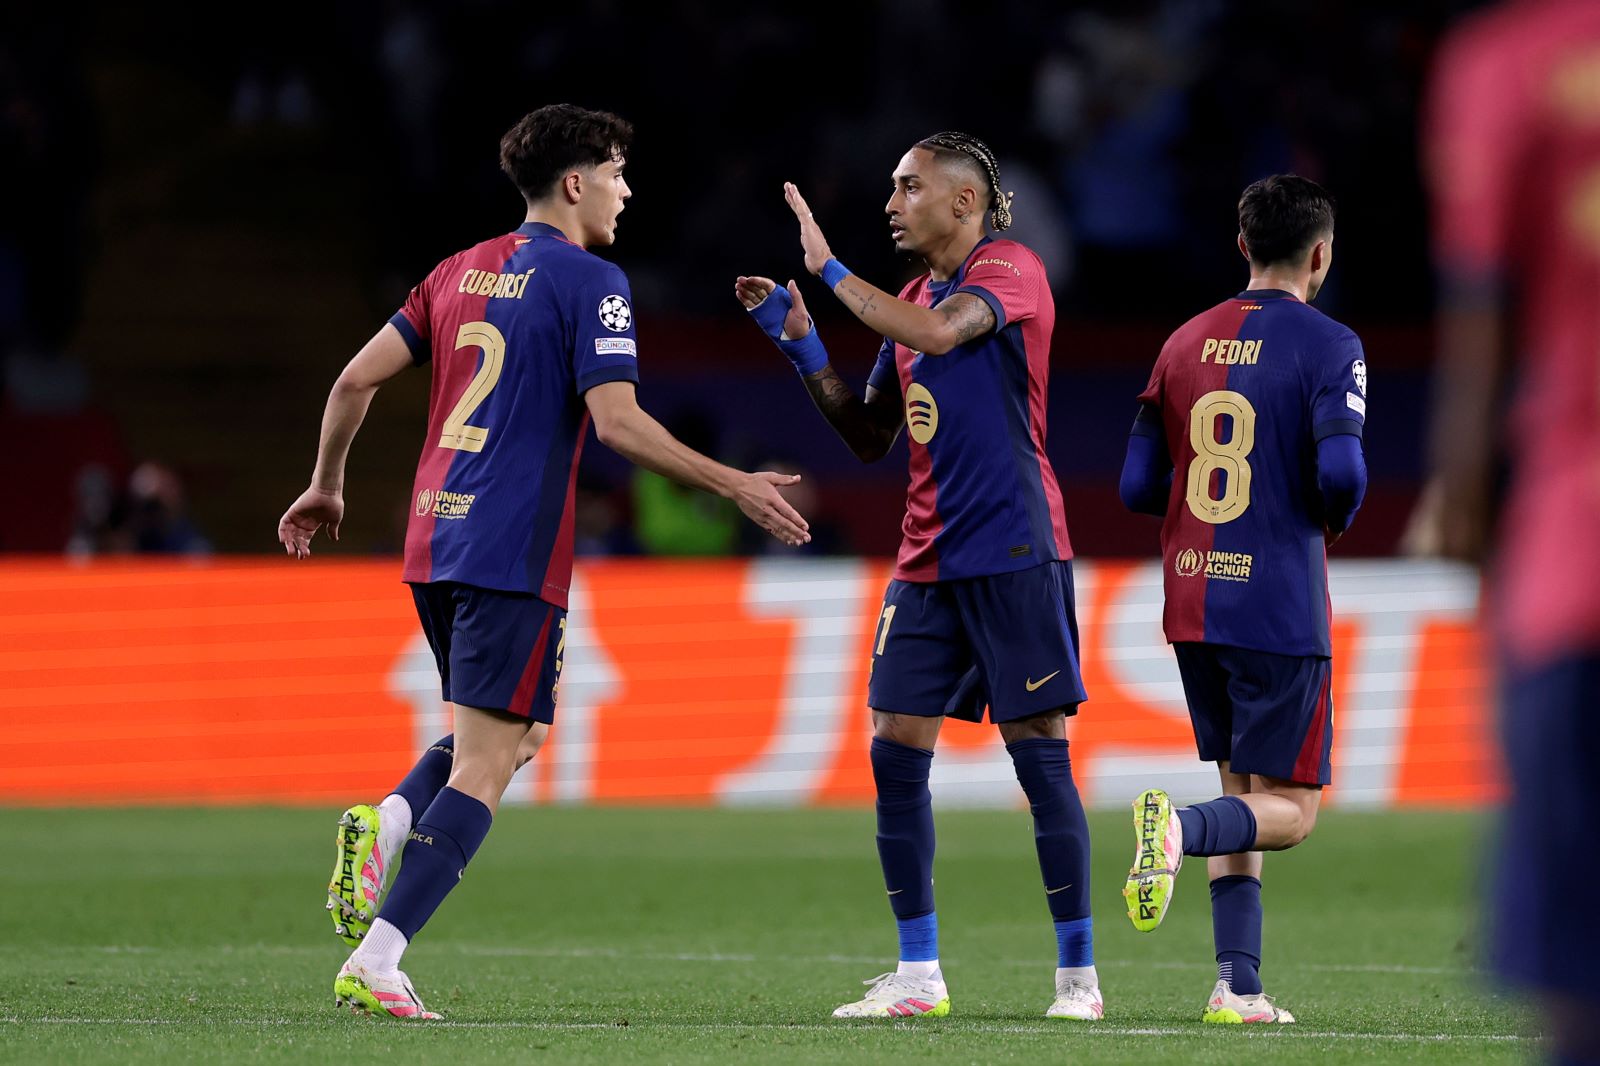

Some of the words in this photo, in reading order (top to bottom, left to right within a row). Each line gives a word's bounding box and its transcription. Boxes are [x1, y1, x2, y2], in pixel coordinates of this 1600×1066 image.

[458, 267, 537, 300] CUBARSÍ
[1200, 338, 1263, 365] PEDRI
[438, 321, 506, 453] 2
[1185, 390, 1256, 524] 8
[432, 502, 470, 515] ACNUR
[435, 490, 475, 504] UNHCR
[1203, 563, 1251, 577] ACNUR
[1206, 551, 1252, 566] UNHCR
[876, 600, 897, 656] 1
[555, 617, 567, 673] 2
